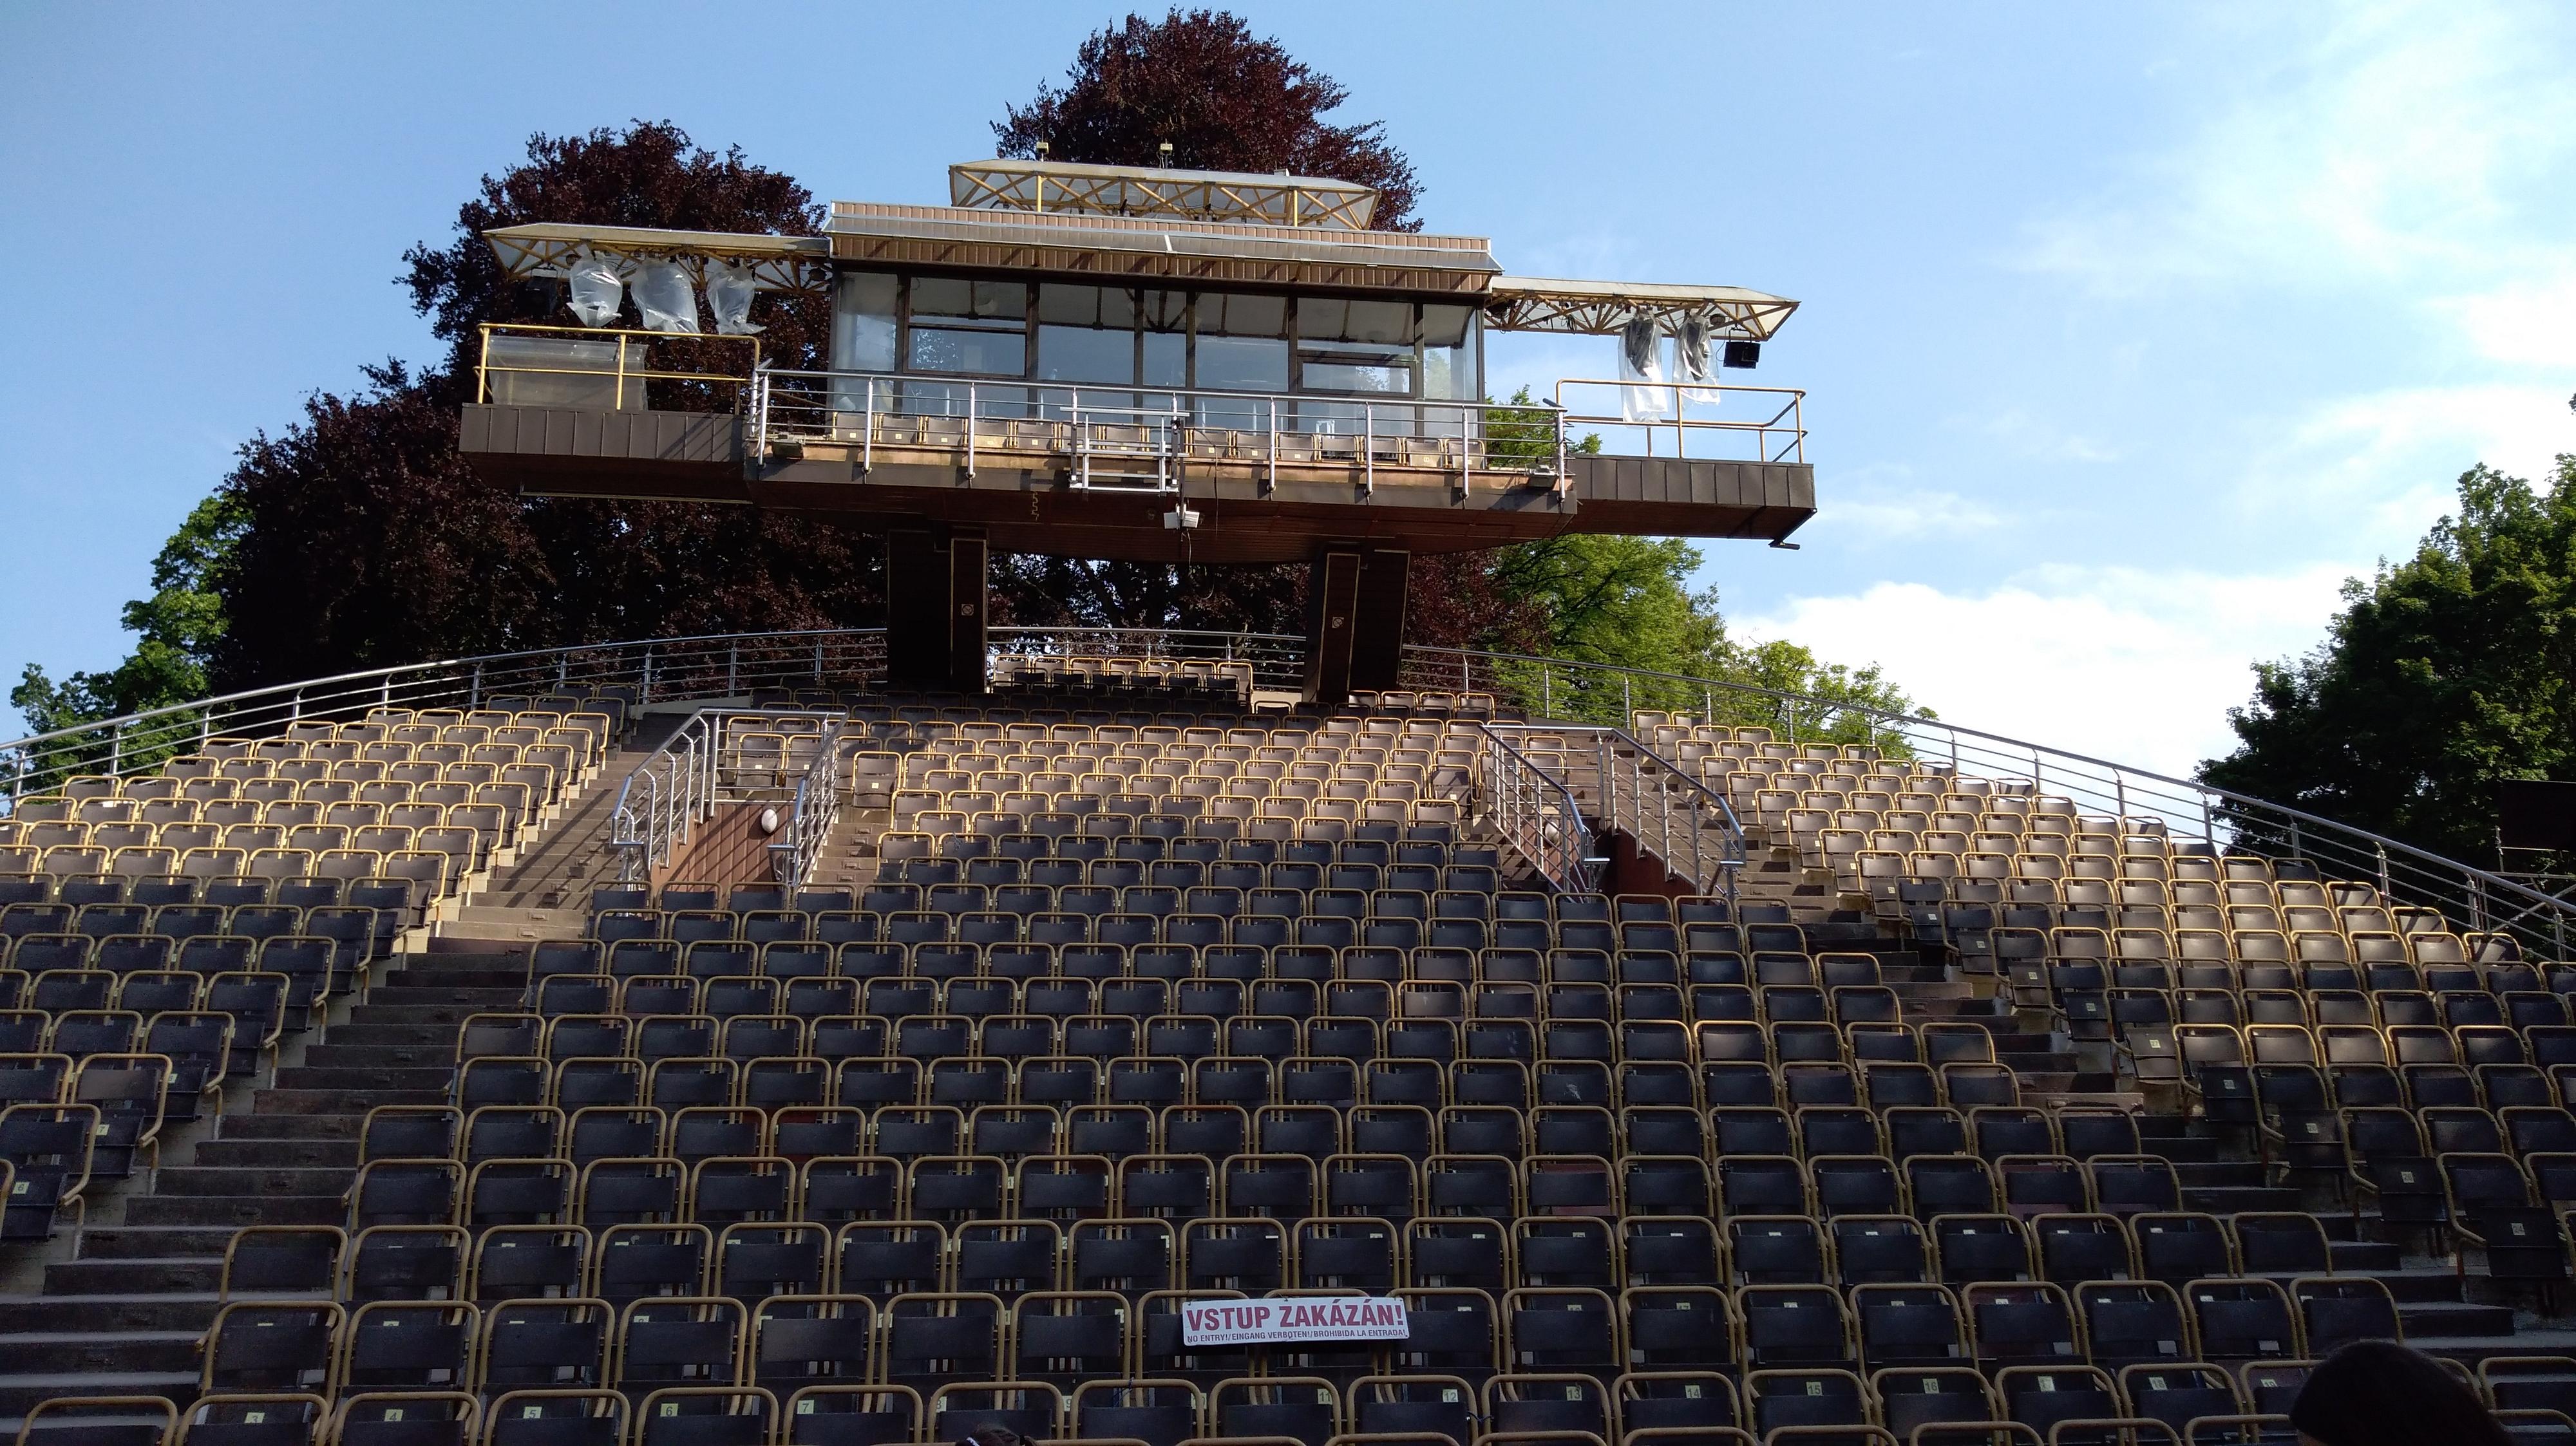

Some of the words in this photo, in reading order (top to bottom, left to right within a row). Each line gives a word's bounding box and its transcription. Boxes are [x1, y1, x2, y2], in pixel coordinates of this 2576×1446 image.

[1186, 1306, 1270, 1331] VSTUP
[1279, 1299, 1404, 1328] ZAKÁZÁN!
[1925, 1382, 1938, 1392] 16
[2152, 1380, 2165, 1389] 18
[1567, 1389, 1580, 1400] 13
[1687, 1388, 1700, 1398] 14
[1808, 1385, 1821, 1395] 15
[1319, 1392, 1331, 1402] 11
[1444, 1392, 1457, 1402] 12
